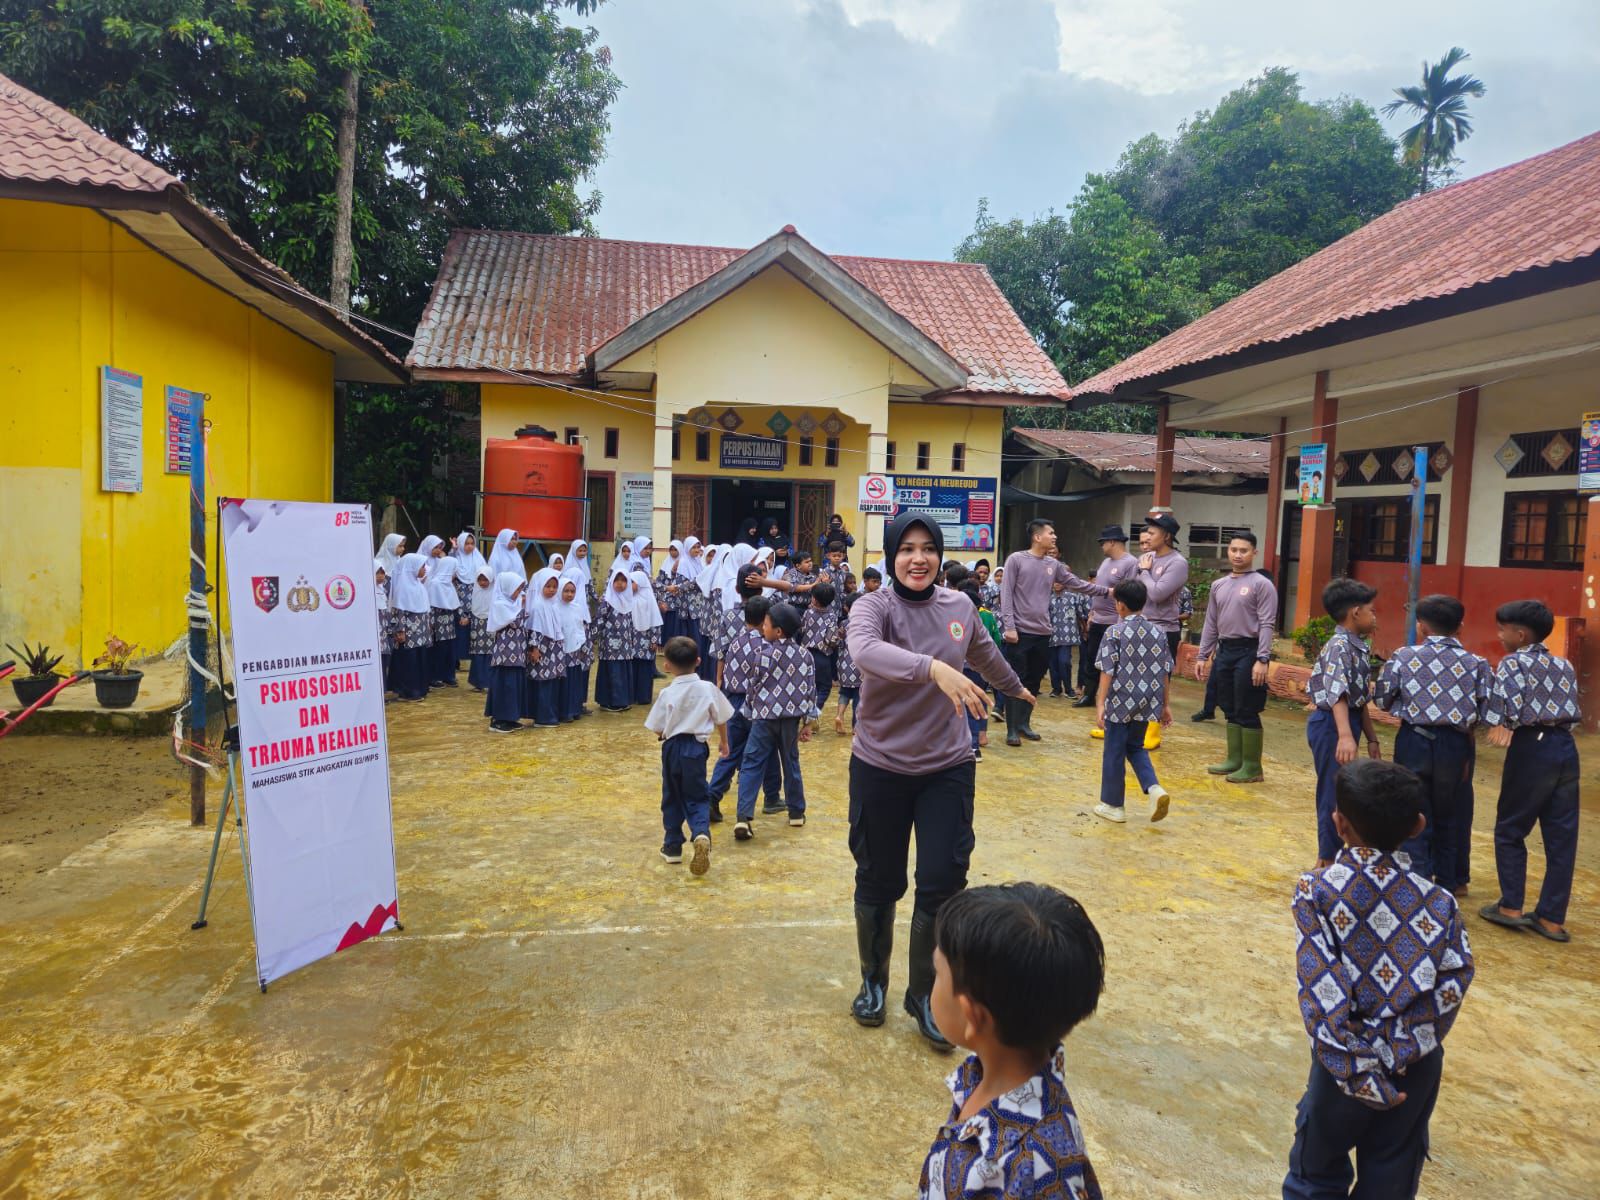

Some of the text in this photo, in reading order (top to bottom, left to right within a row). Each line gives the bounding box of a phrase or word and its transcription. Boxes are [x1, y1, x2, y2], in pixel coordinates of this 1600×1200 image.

[723, 440, 781, 457] PERPUSTAKAAN
[896, 477, 906, 486] SD
[907, 477, 933, 487] NEGERI
[933, 478, 938, 487] 4
[900, 490, 926, 499] STOP
[859, 504, 873, 512] ASAP
[336, 511, 350, 526] 83
[242, 648, 373, 674] PENGABDIAN MASYARAKAT
[260, 671, 362, 705] PSIKOSOSIAL
[299, 704, 330, 728] DAN
[249, 723, 379, 768] TRAUMA HEALING
[252, 753, 379, 789] MAHASISWA STIK ANGKATAN 83/WPS
